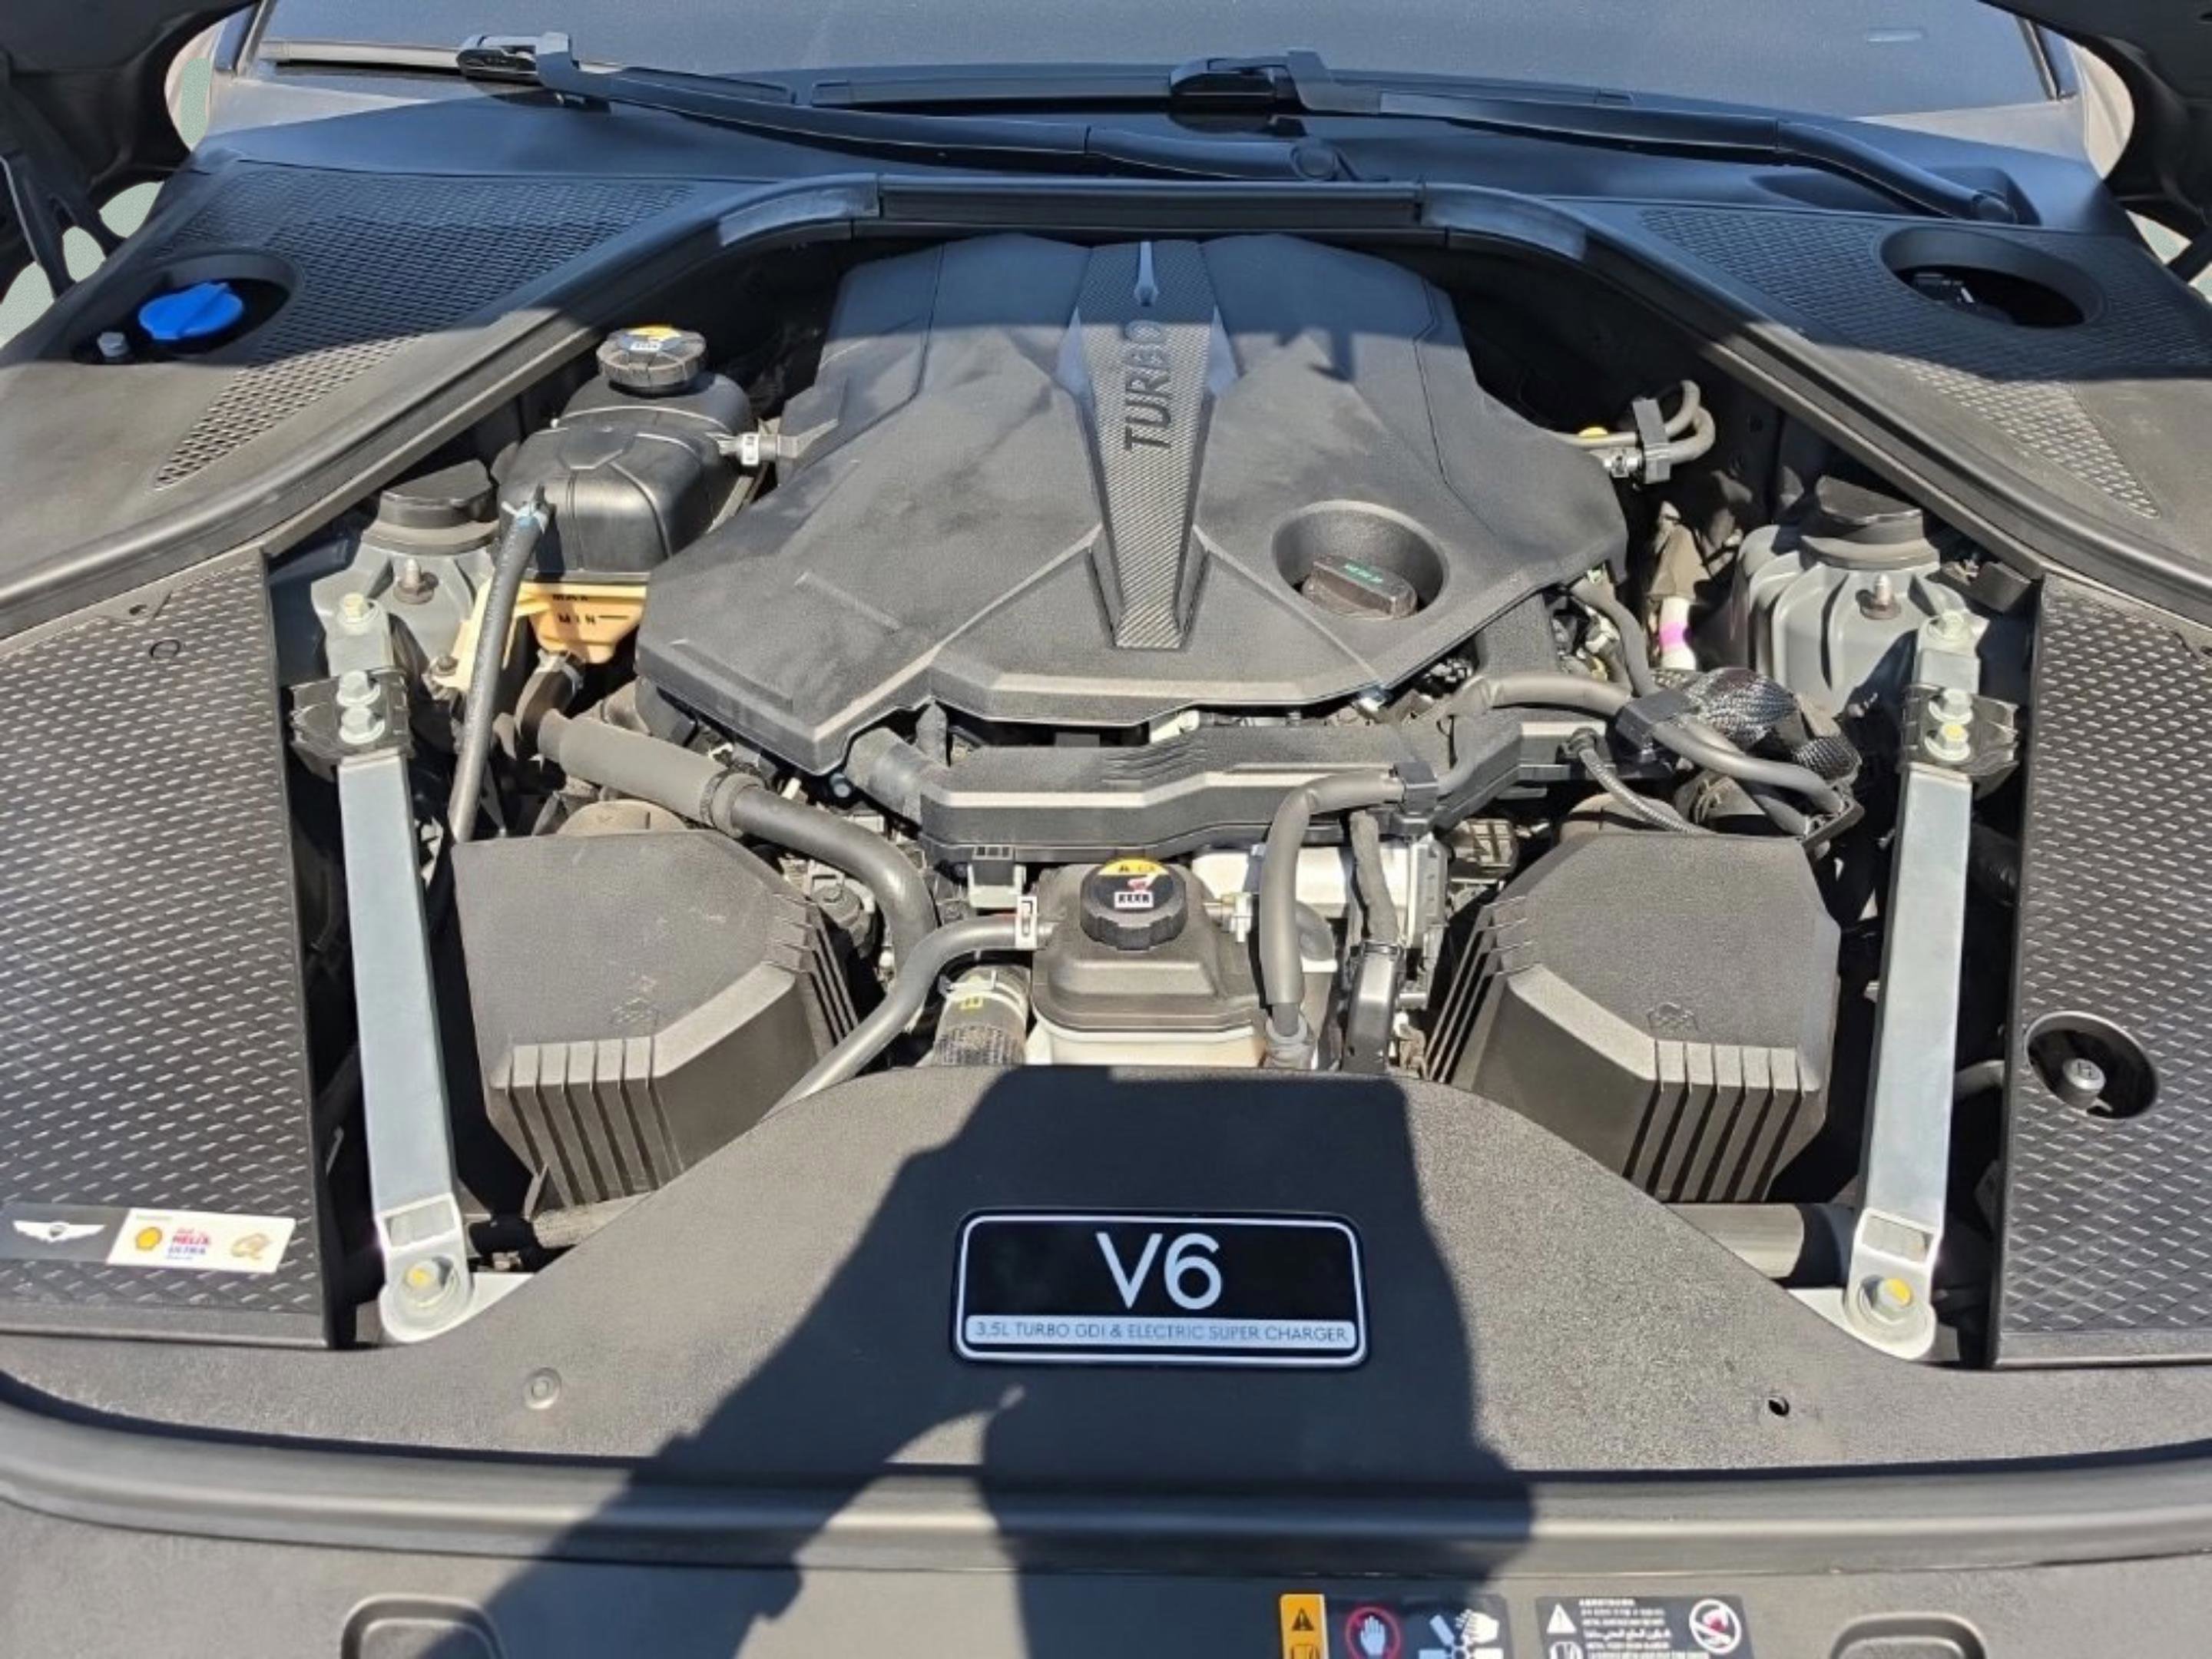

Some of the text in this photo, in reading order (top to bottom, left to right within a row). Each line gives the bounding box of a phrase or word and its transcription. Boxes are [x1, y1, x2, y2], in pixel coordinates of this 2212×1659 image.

[1122, 320, 1172, 452] TURBO
[1095, 1232, 1222, 1310] V6
[975, 1321, 1348, 1343] 3.5L TURBO GDI & ELECTRIC SUPER CHARGER
